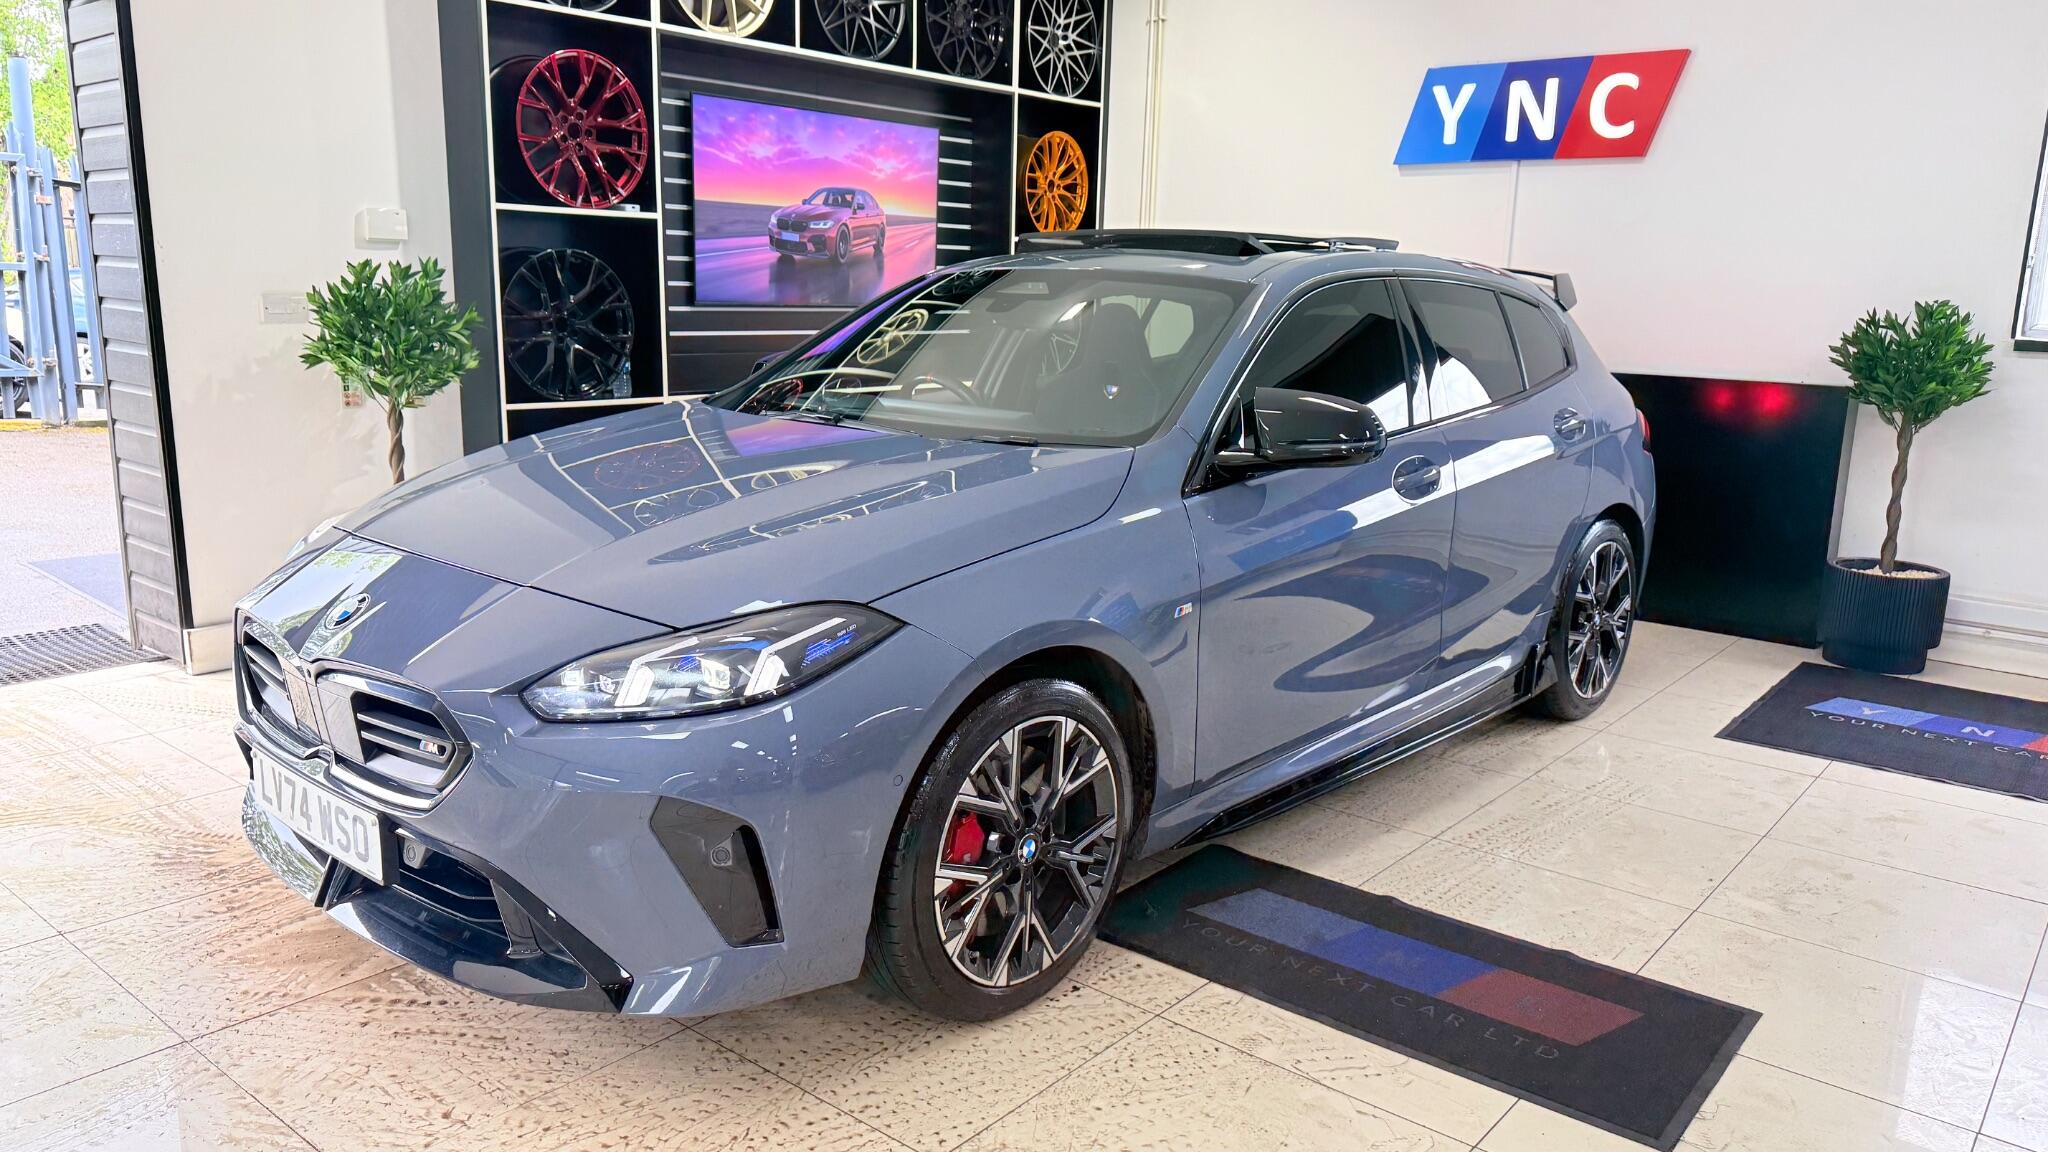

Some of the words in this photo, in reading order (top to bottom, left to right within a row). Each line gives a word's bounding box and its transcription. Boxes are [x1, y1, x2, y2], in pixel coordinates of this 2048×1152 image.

[1432, 72, 1640, 145] YNC
[1810, 711, 1886, 730] YOUR
[1901, 728, 1978, 746] NEXT
[260, 758, 313, 832] LV74
[318, 794, 370, 863] WSO
[1183, 916, 1268, 953] YOUR
[1281, 956, 1376, 993] NEXT
[1391, 995, 1465, 1028] CAR
[1484, 1027, 1560, 1059] LTD
